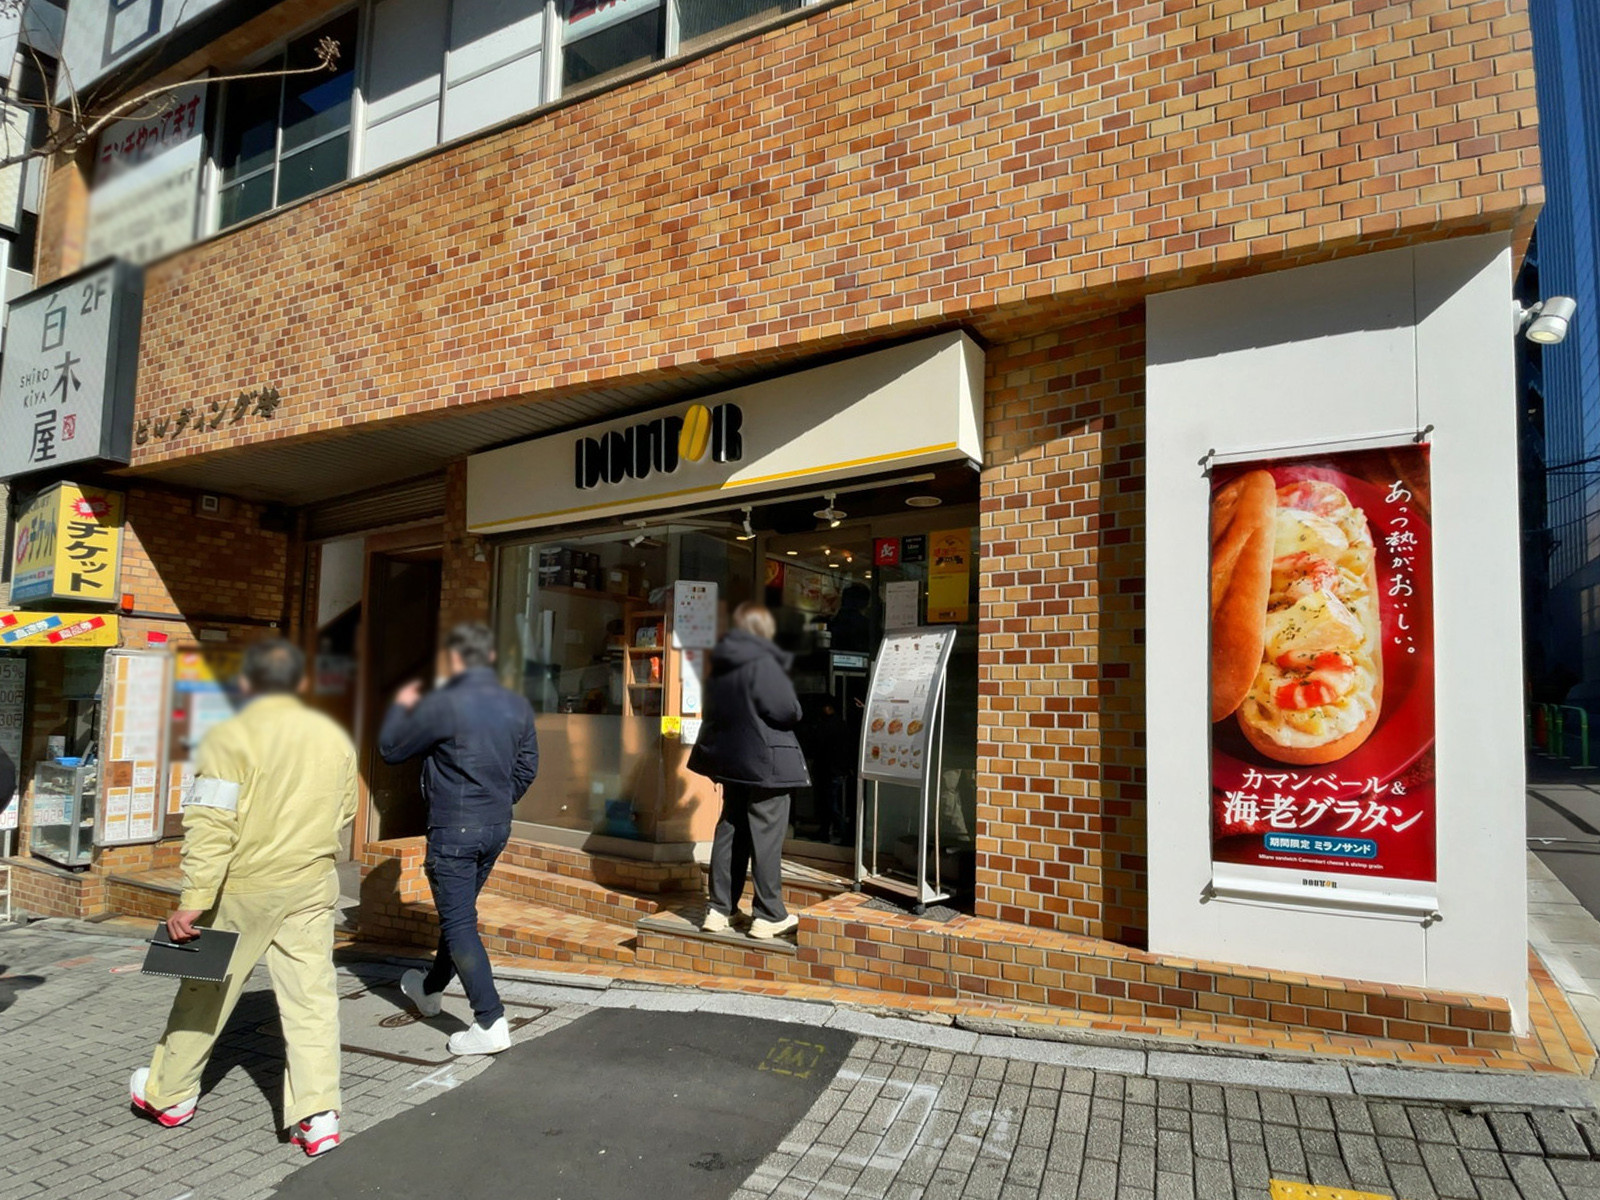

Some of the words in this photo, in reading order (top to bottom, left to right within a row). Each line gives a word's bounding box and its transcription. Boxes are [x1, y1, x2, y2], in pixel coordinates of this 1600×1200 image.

[80, 276, 109, 315] 2F
[28, 294, 82, 463] 白木屋
[575, 403, 743, 490] DOUTOR
[64, 520, 109, 592] チケット
[1223, 791, 1424, 833] 海老グラタン
[1269, 837, 1311, 850] 期間限定
[1314, 840, 1372, 854] ミラノサンド
